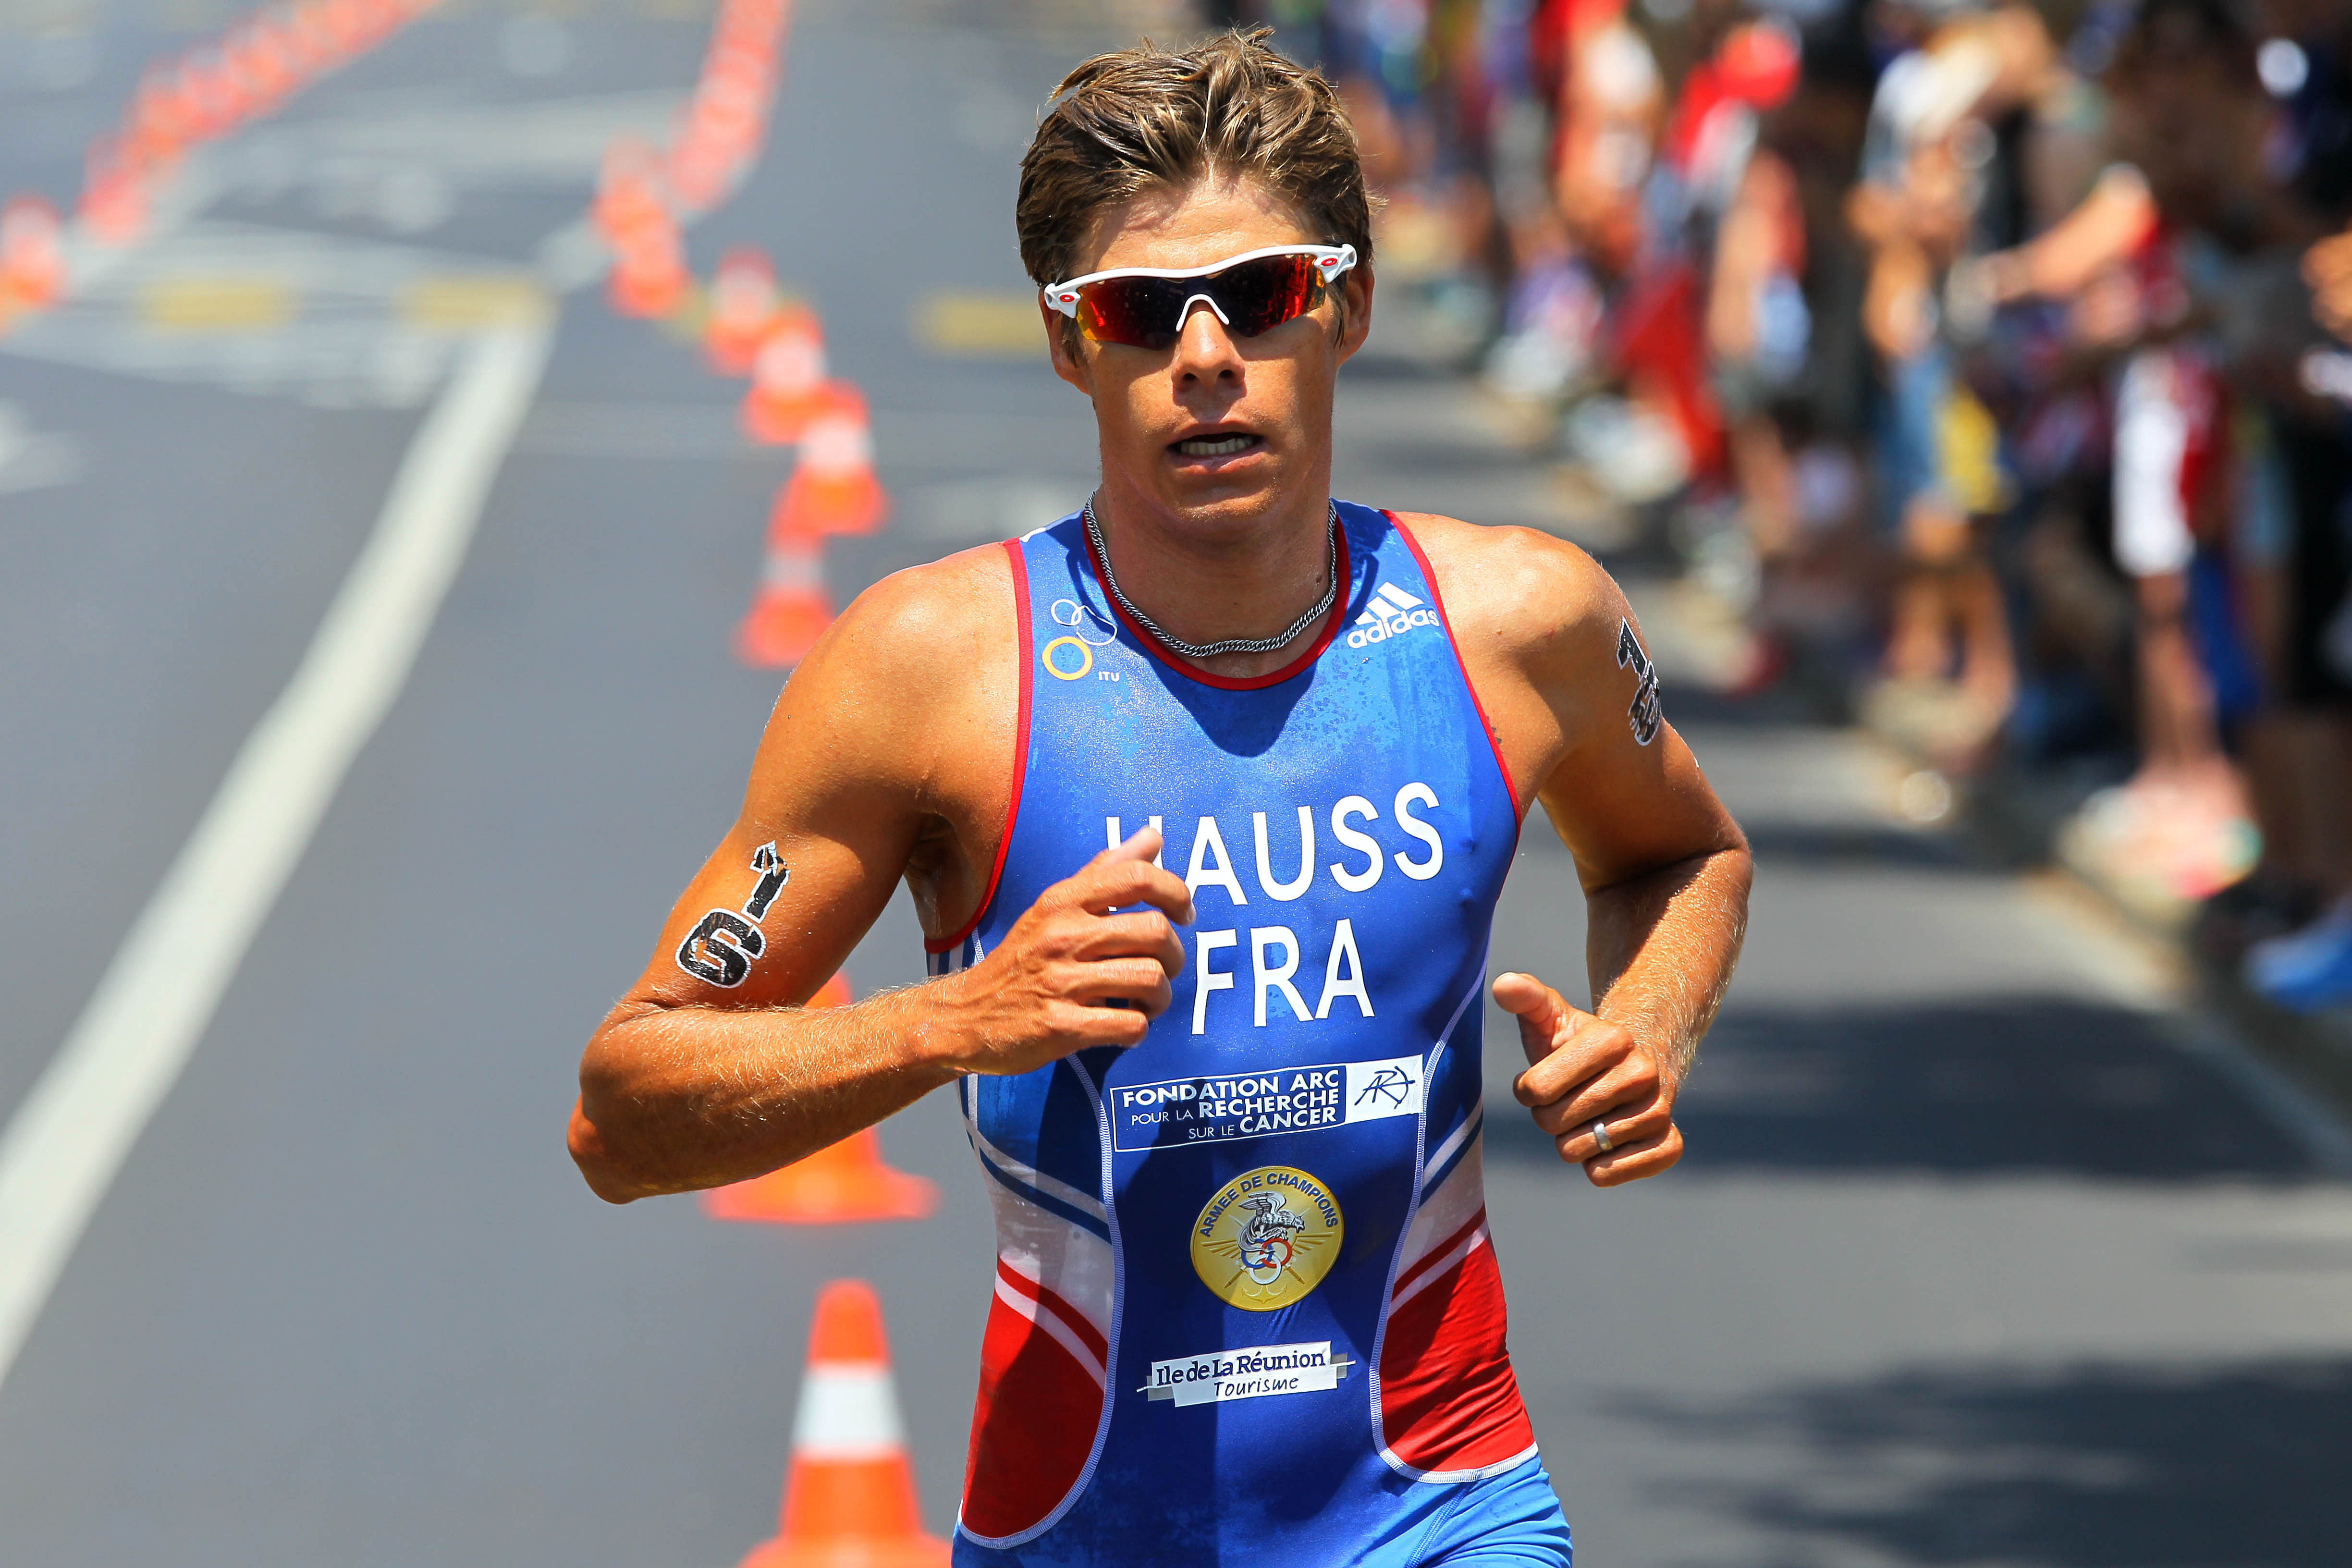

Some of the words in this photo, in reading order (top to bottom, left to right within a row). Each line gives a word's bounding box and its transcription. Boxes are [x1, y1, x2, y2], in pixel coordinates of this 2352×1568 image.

[1347, 609, 1440, 649] adidas
[1098, 671, 1120, 682] ITU
[674, 840, 791, 988] 16
[1191, 918, 1375, 1035] FRA
[1123, 1076, 1279, 1107] FONDATION
[1290, 1069, 1339, 1091] ARC
[1132, 1112, 1169, 1126] POUR
[1176, 1109, 1194, 1120] LA
[1199, 1088, 1339, 1118] RECHERCHE
[1188, 1127, 1214, 1139] SUR
[1222, 1125, 1235, 1136] LE
[1240, 1106, 1337, 1133] CANCER
[1200, 1188, 1240, 1237] ARMEE
[1240, 1175, 1263, 1193] DE
[1267, 1173, 1338, 1228] CHAMPIONS
[1214, 1377, 1299, 1396] Tourisme
